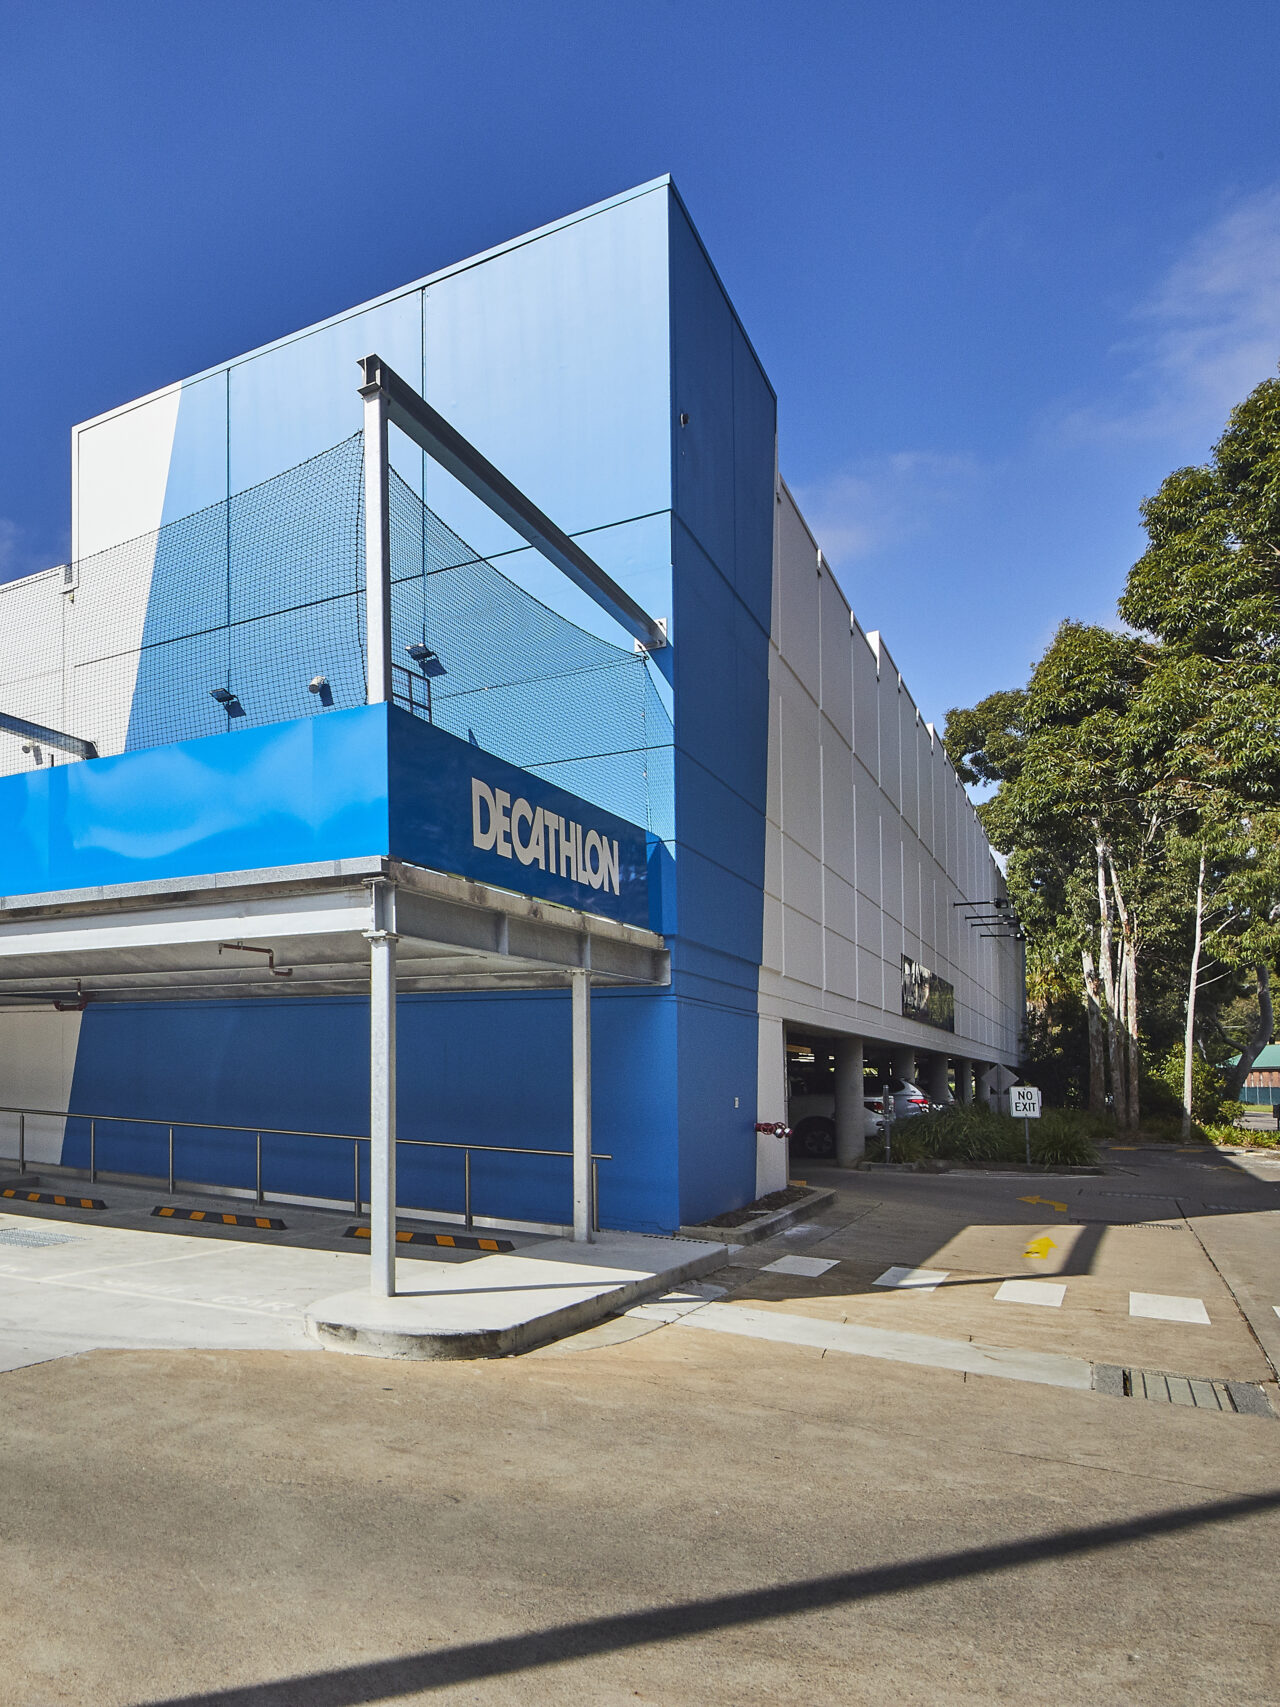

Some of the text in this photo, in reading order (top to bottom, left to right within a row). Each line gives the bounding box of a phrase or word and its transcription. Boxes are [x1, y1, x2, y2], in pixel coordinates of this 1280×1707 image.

[472, 777, 620, 896] DECATHLON
[1017, 1091, 1033, 1101] NO
[1015, 1102, 1037, 1112] EXIT
